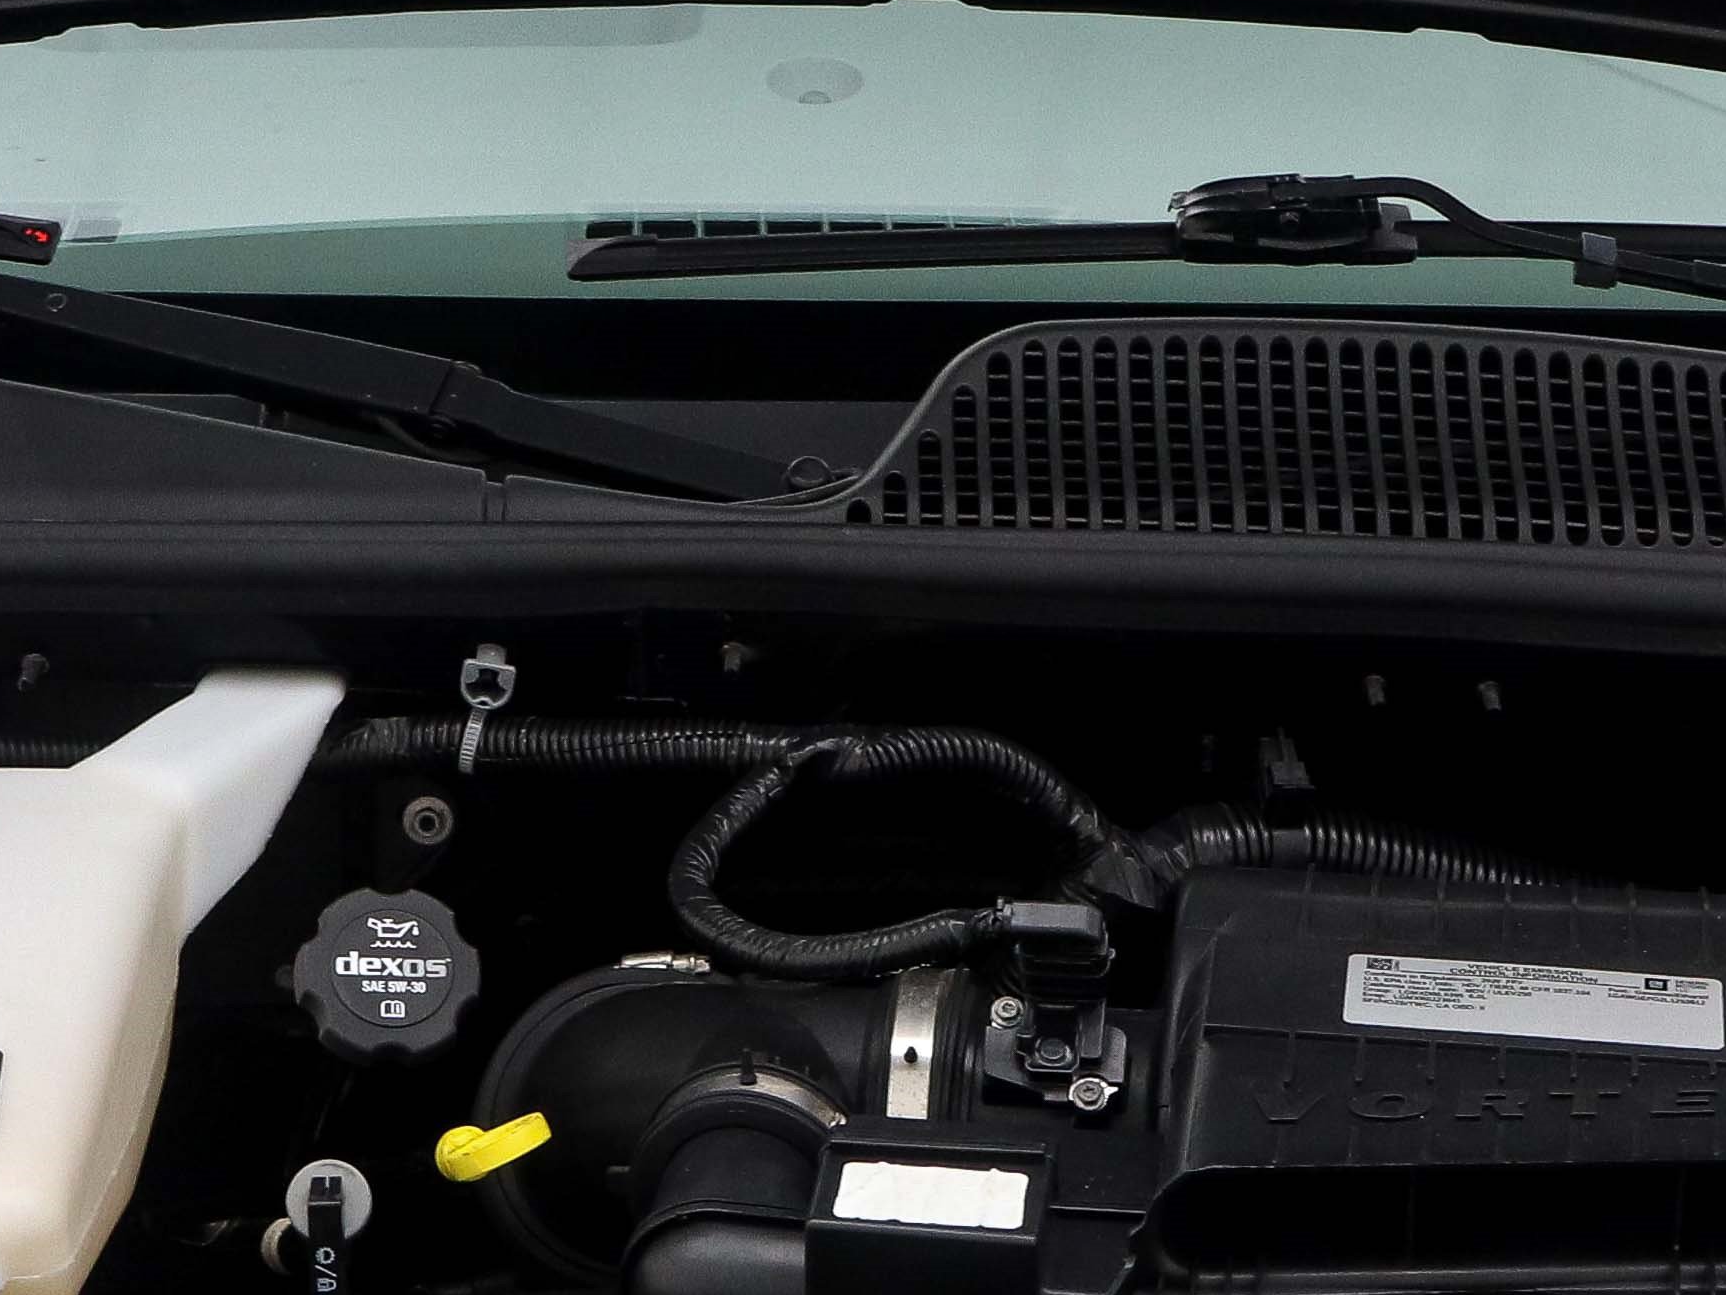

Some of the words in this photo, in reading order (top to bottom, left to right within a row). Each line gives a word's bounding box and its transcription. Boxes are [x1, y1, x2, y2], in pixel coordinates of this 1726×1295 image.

[335, 950, 449, 979] dexos
[1450, 968, 1506, 977] CONTROL
[361, 980, 386, 993] SAE
[387, 981, 427, 994] 5W-30
